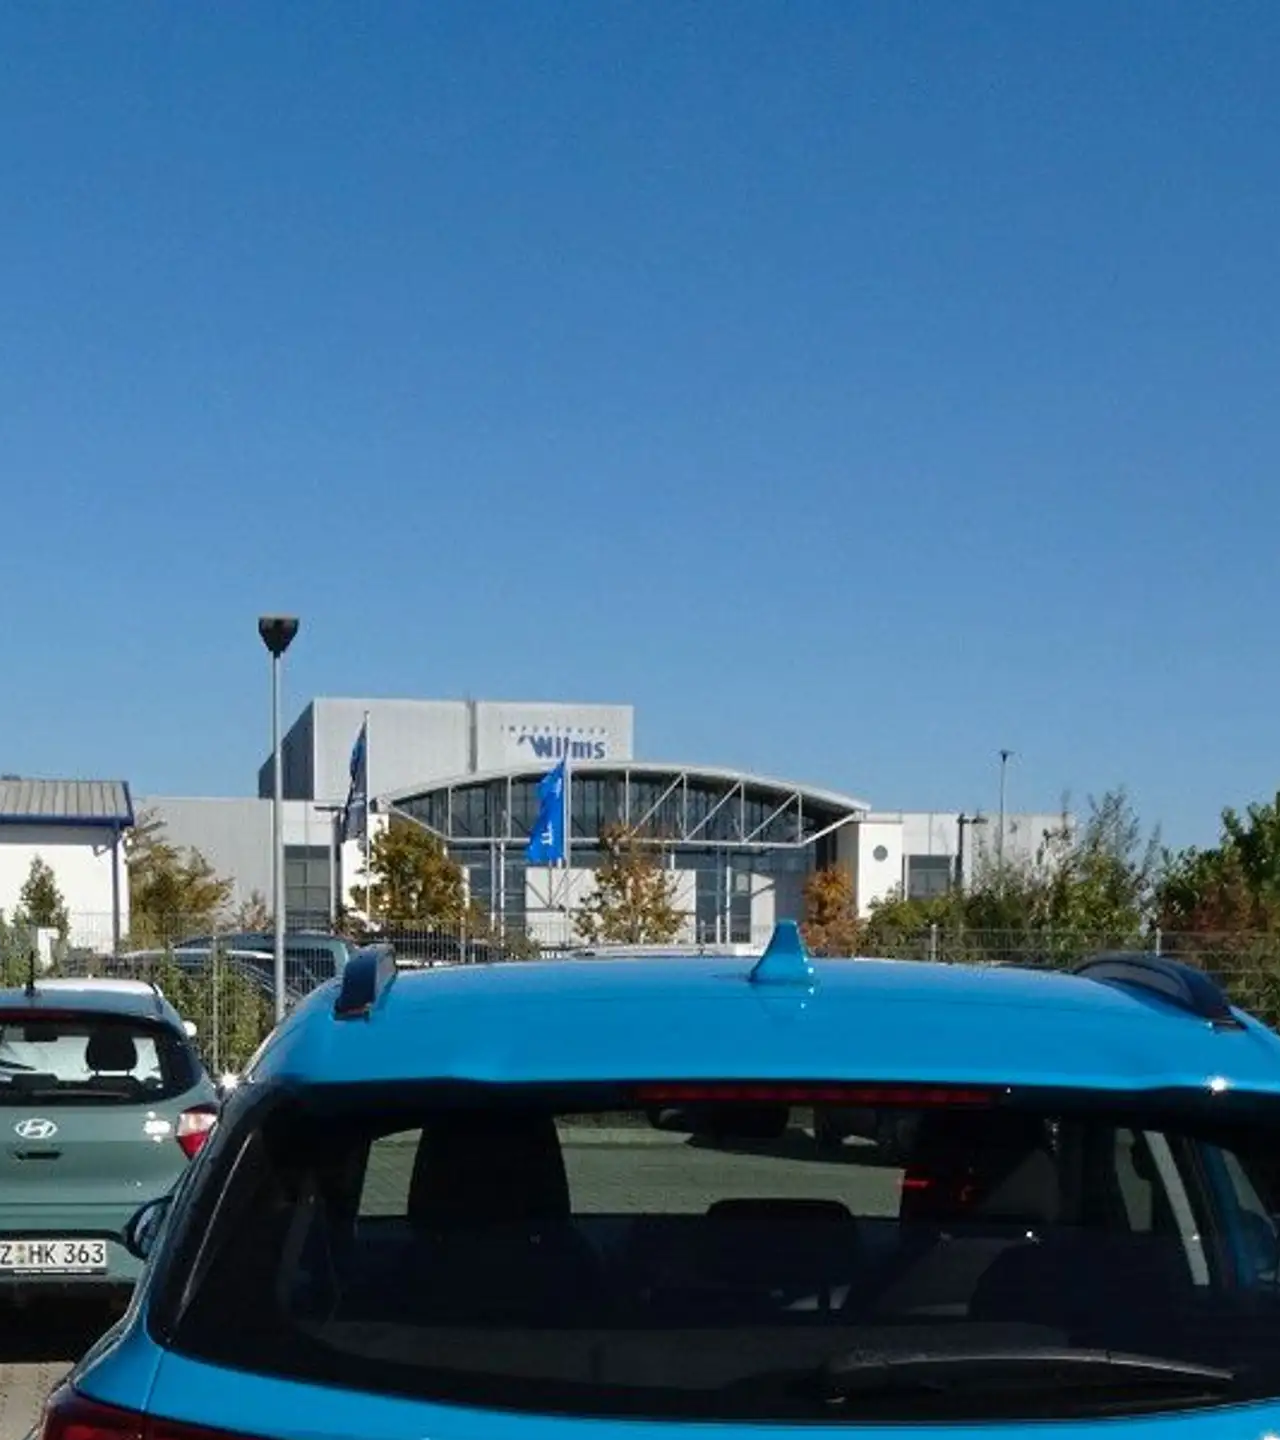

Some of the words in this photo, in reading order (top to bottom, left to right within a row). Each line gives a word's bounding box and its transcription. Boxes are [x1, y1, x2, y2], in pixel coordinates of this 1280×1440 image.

[518, 734, 606, 760] Wilms
[28, 1243, 57, 1264] HK
[63, 1243, 104, 1264] 363
